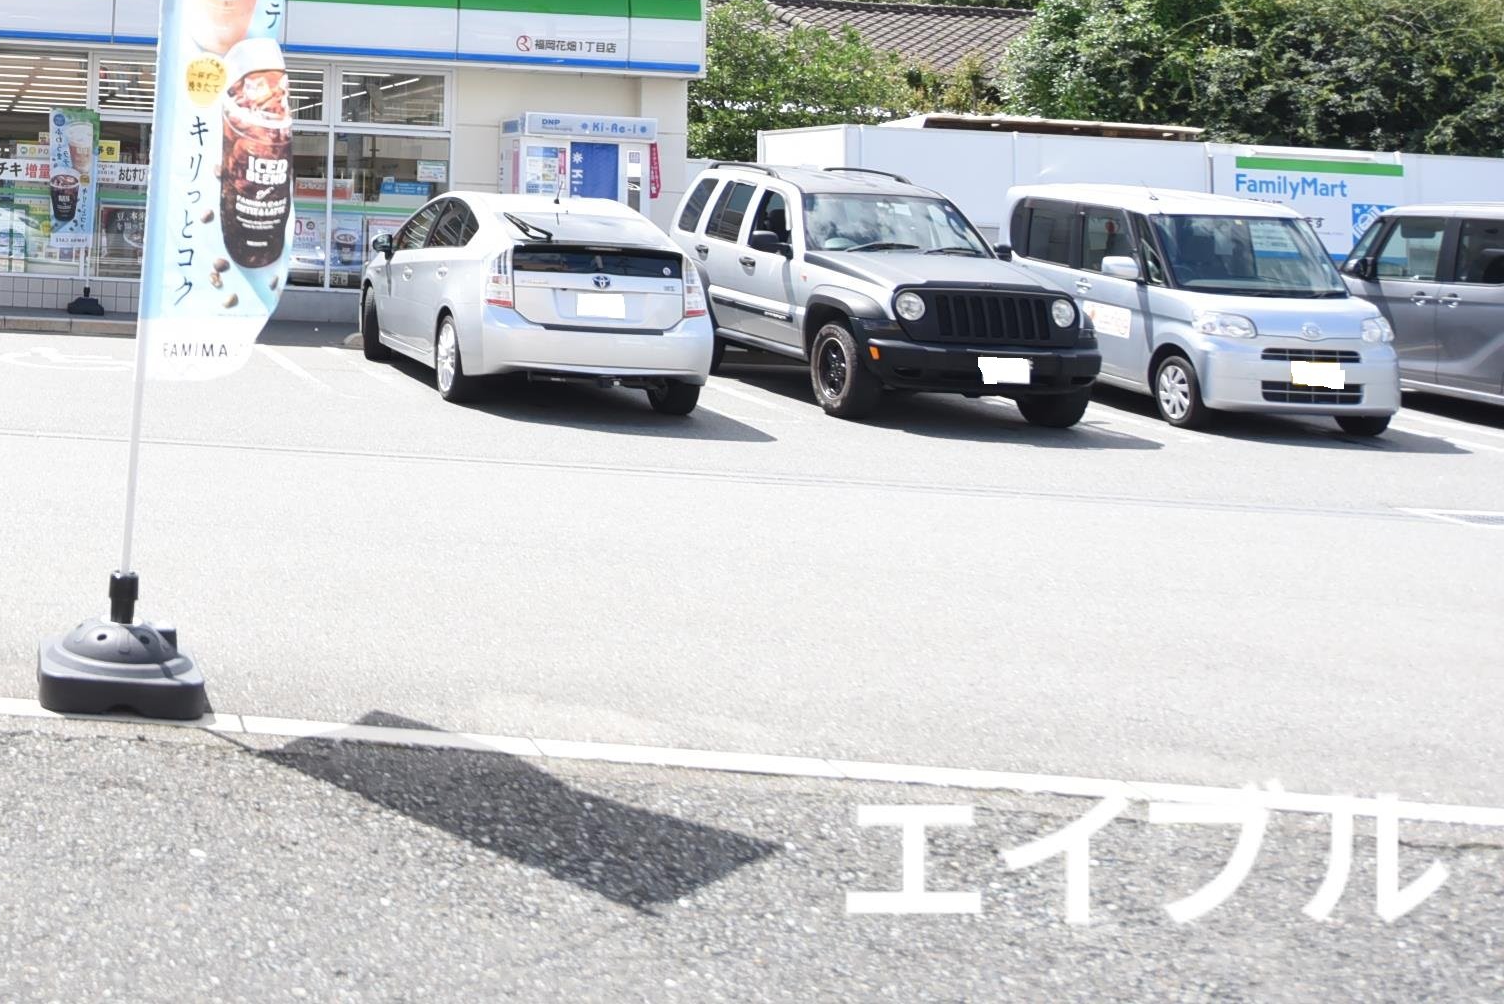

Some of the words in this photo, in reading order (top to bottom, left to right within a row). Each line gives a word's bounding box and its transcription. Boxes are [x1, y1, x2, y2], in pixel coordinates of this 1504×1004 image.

[535, 39, 617, 53] 福岡花畑1丁目店
[248, 156, 289, 175] ICED
[246, 170, 287, 185] BLEND
[1235, 174, 1348, 200] FamilyMart
[175, 116, 209, 306] キリっとコク
[163, 342, 228, 357] FAMIMA
